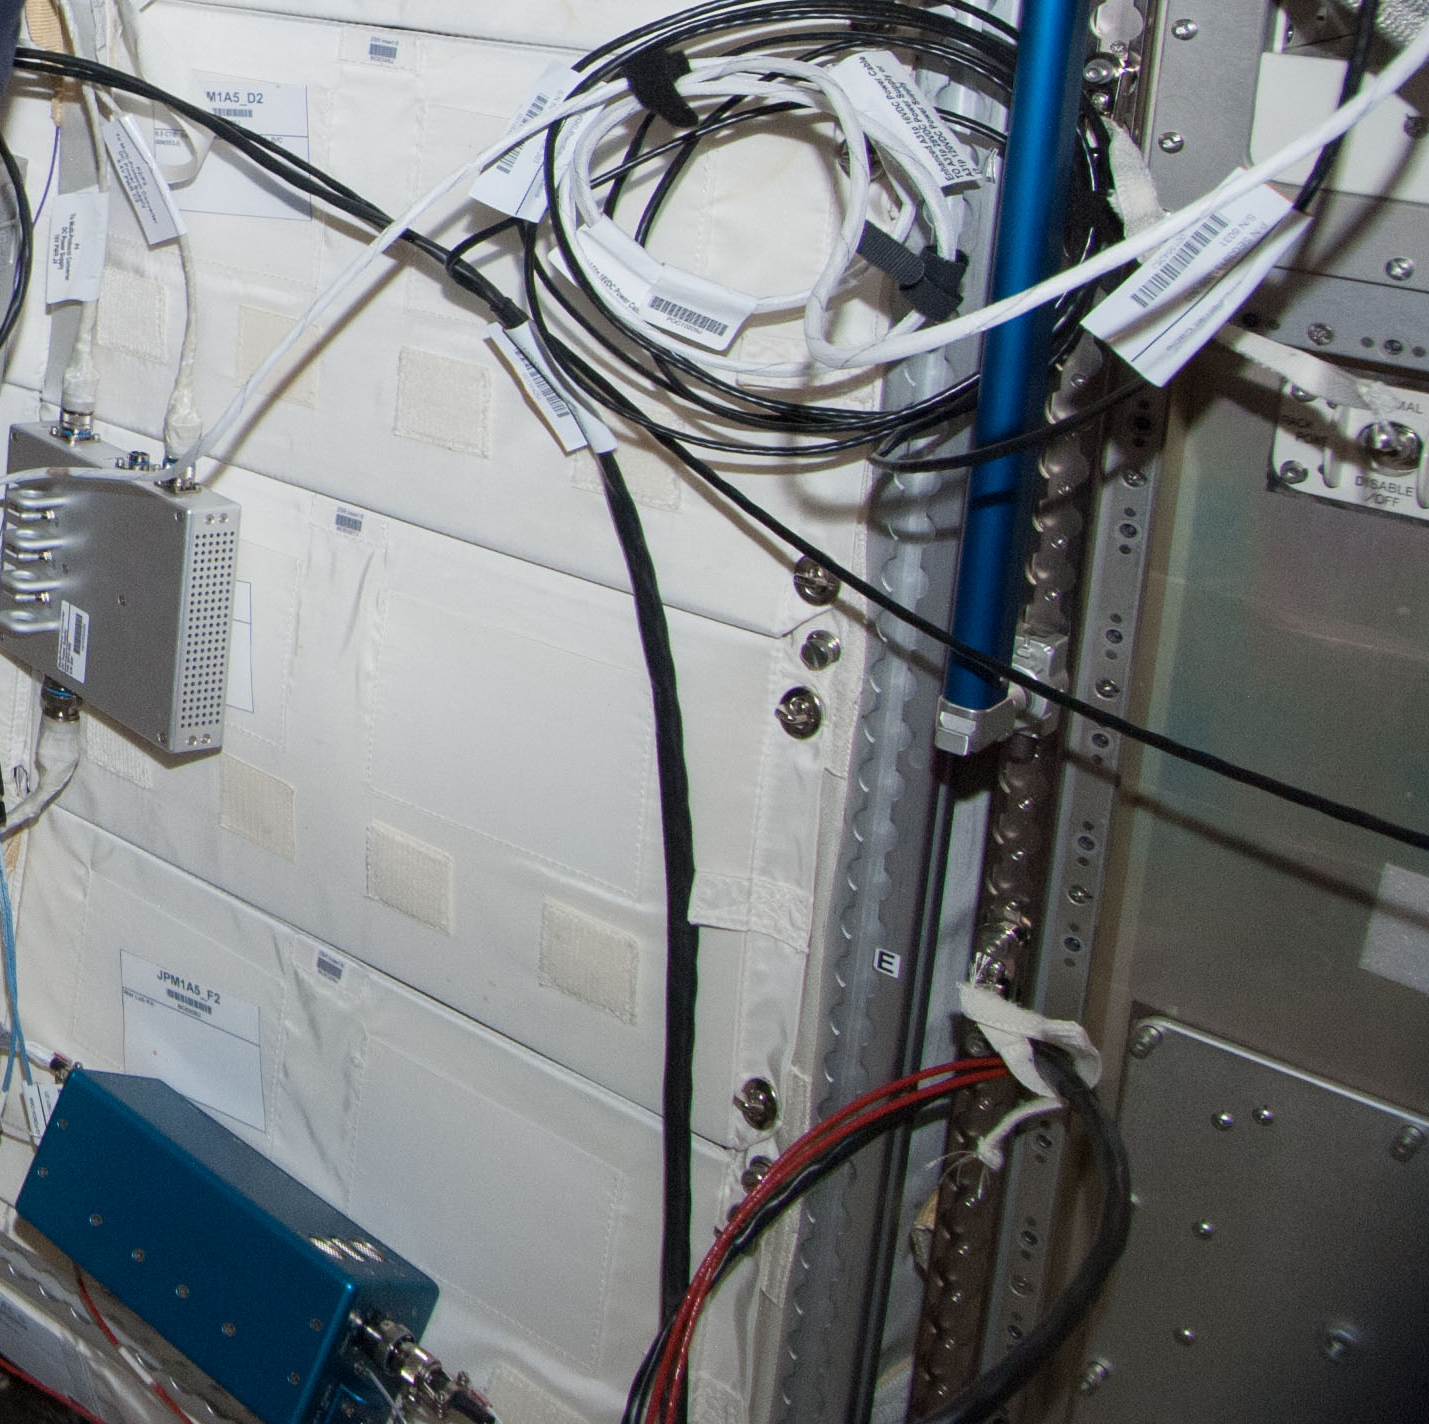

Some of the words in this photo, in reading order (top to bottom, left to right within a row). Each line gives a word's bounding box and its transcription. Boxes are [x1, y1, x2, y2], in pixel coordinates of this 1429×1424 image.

[859, 56, 877, 77] Cable
[206, 91, 264, 106] M1A5_D2
[875, 77, 894, 101] Power
[885, 74, 905, 100] Supply
[898, 81, 921, 107] Supply
[903, 99, 923, 124] Power
[918, 106, 938, 130] Power
[924, 145, 955, 182] Enhanced
[951, 168, 964, 180] TO
[1355, 476, 1414, 497] DISABLE
[1364, 492, 1400, 506] /OFF
[877, 951, 895, 974] E
[157, 969, 221, 1005] JPM1A5_F2
